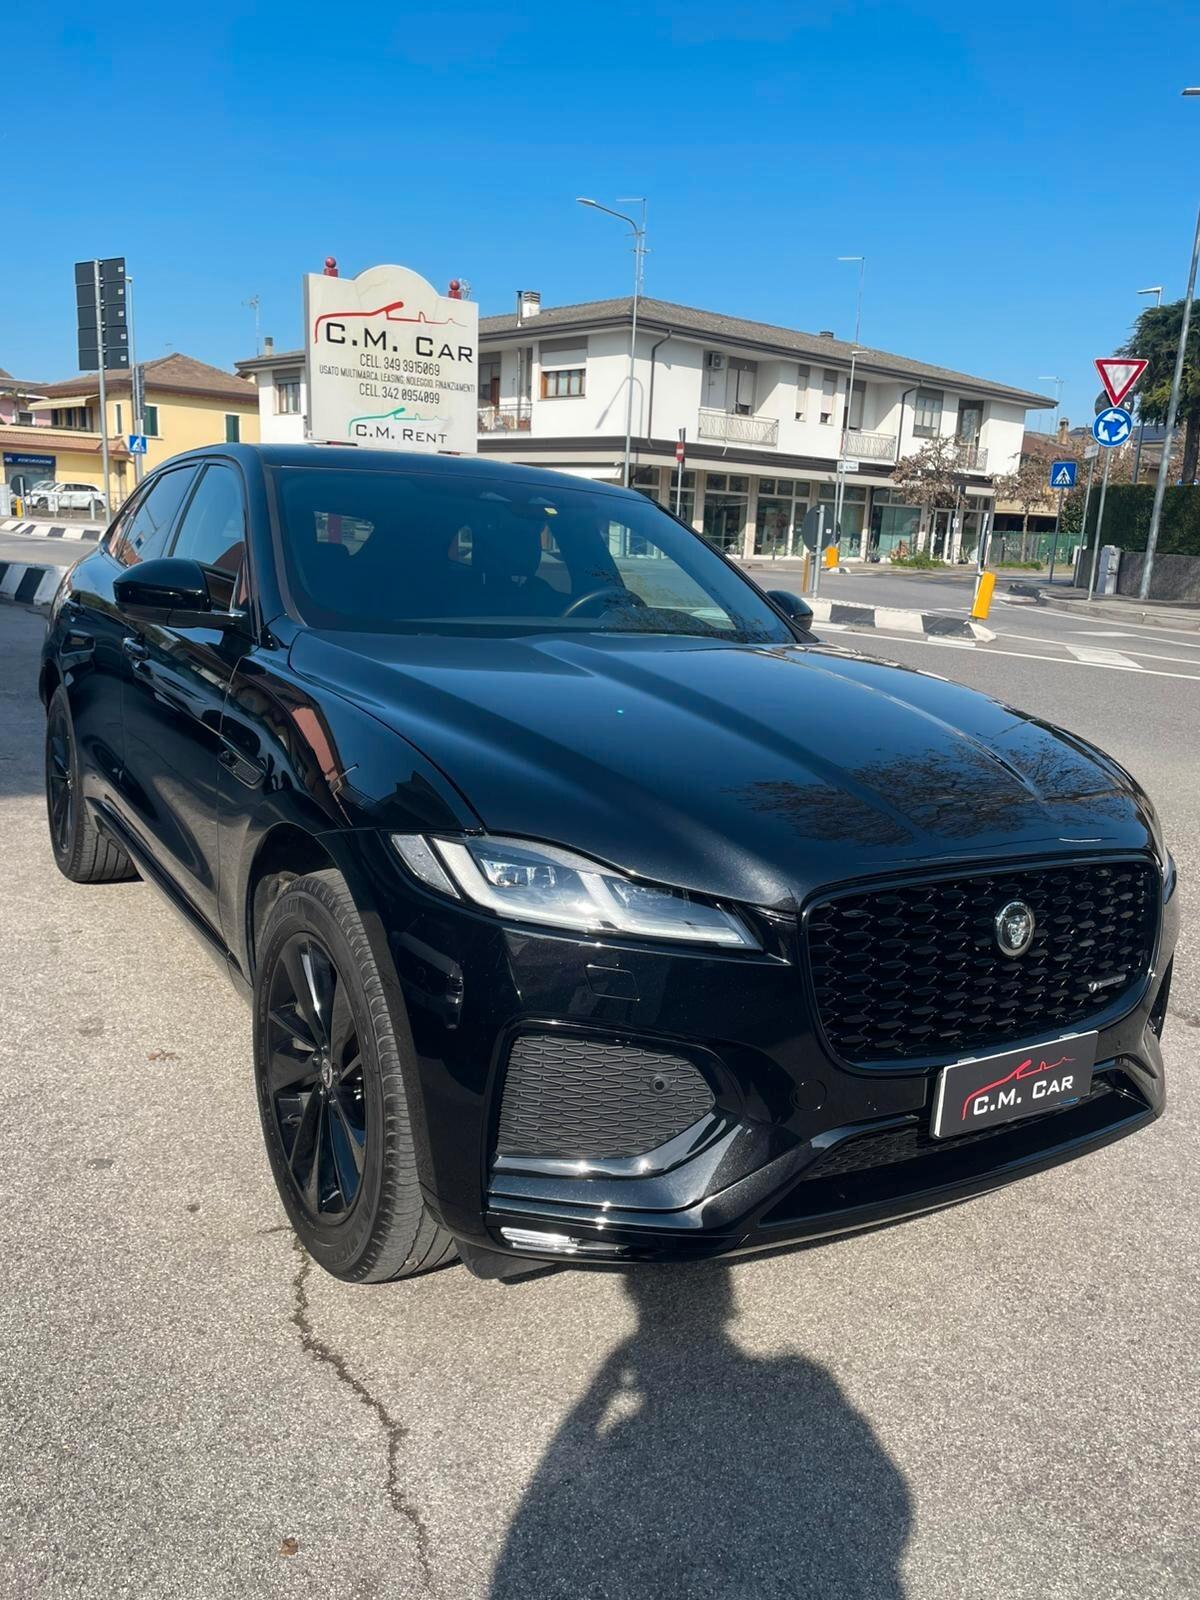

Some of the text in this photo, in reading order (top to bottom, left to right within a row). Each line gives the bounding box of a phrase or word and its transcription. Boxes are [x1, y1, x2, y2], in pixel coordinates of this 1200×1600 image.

[326, 322, 398, 352] C.M.
[360, 353, 440, 376] CELL. 349 3915069
[319, 364, 339, 376] USATO
[435, 380, 475, 393] FINANZIAMENTI
[359, 382, 440, 404] CELL. 342 0954099
[356, 424, 395, 440] C.M.
[973, 1088, 1022, 1115] C.M.
